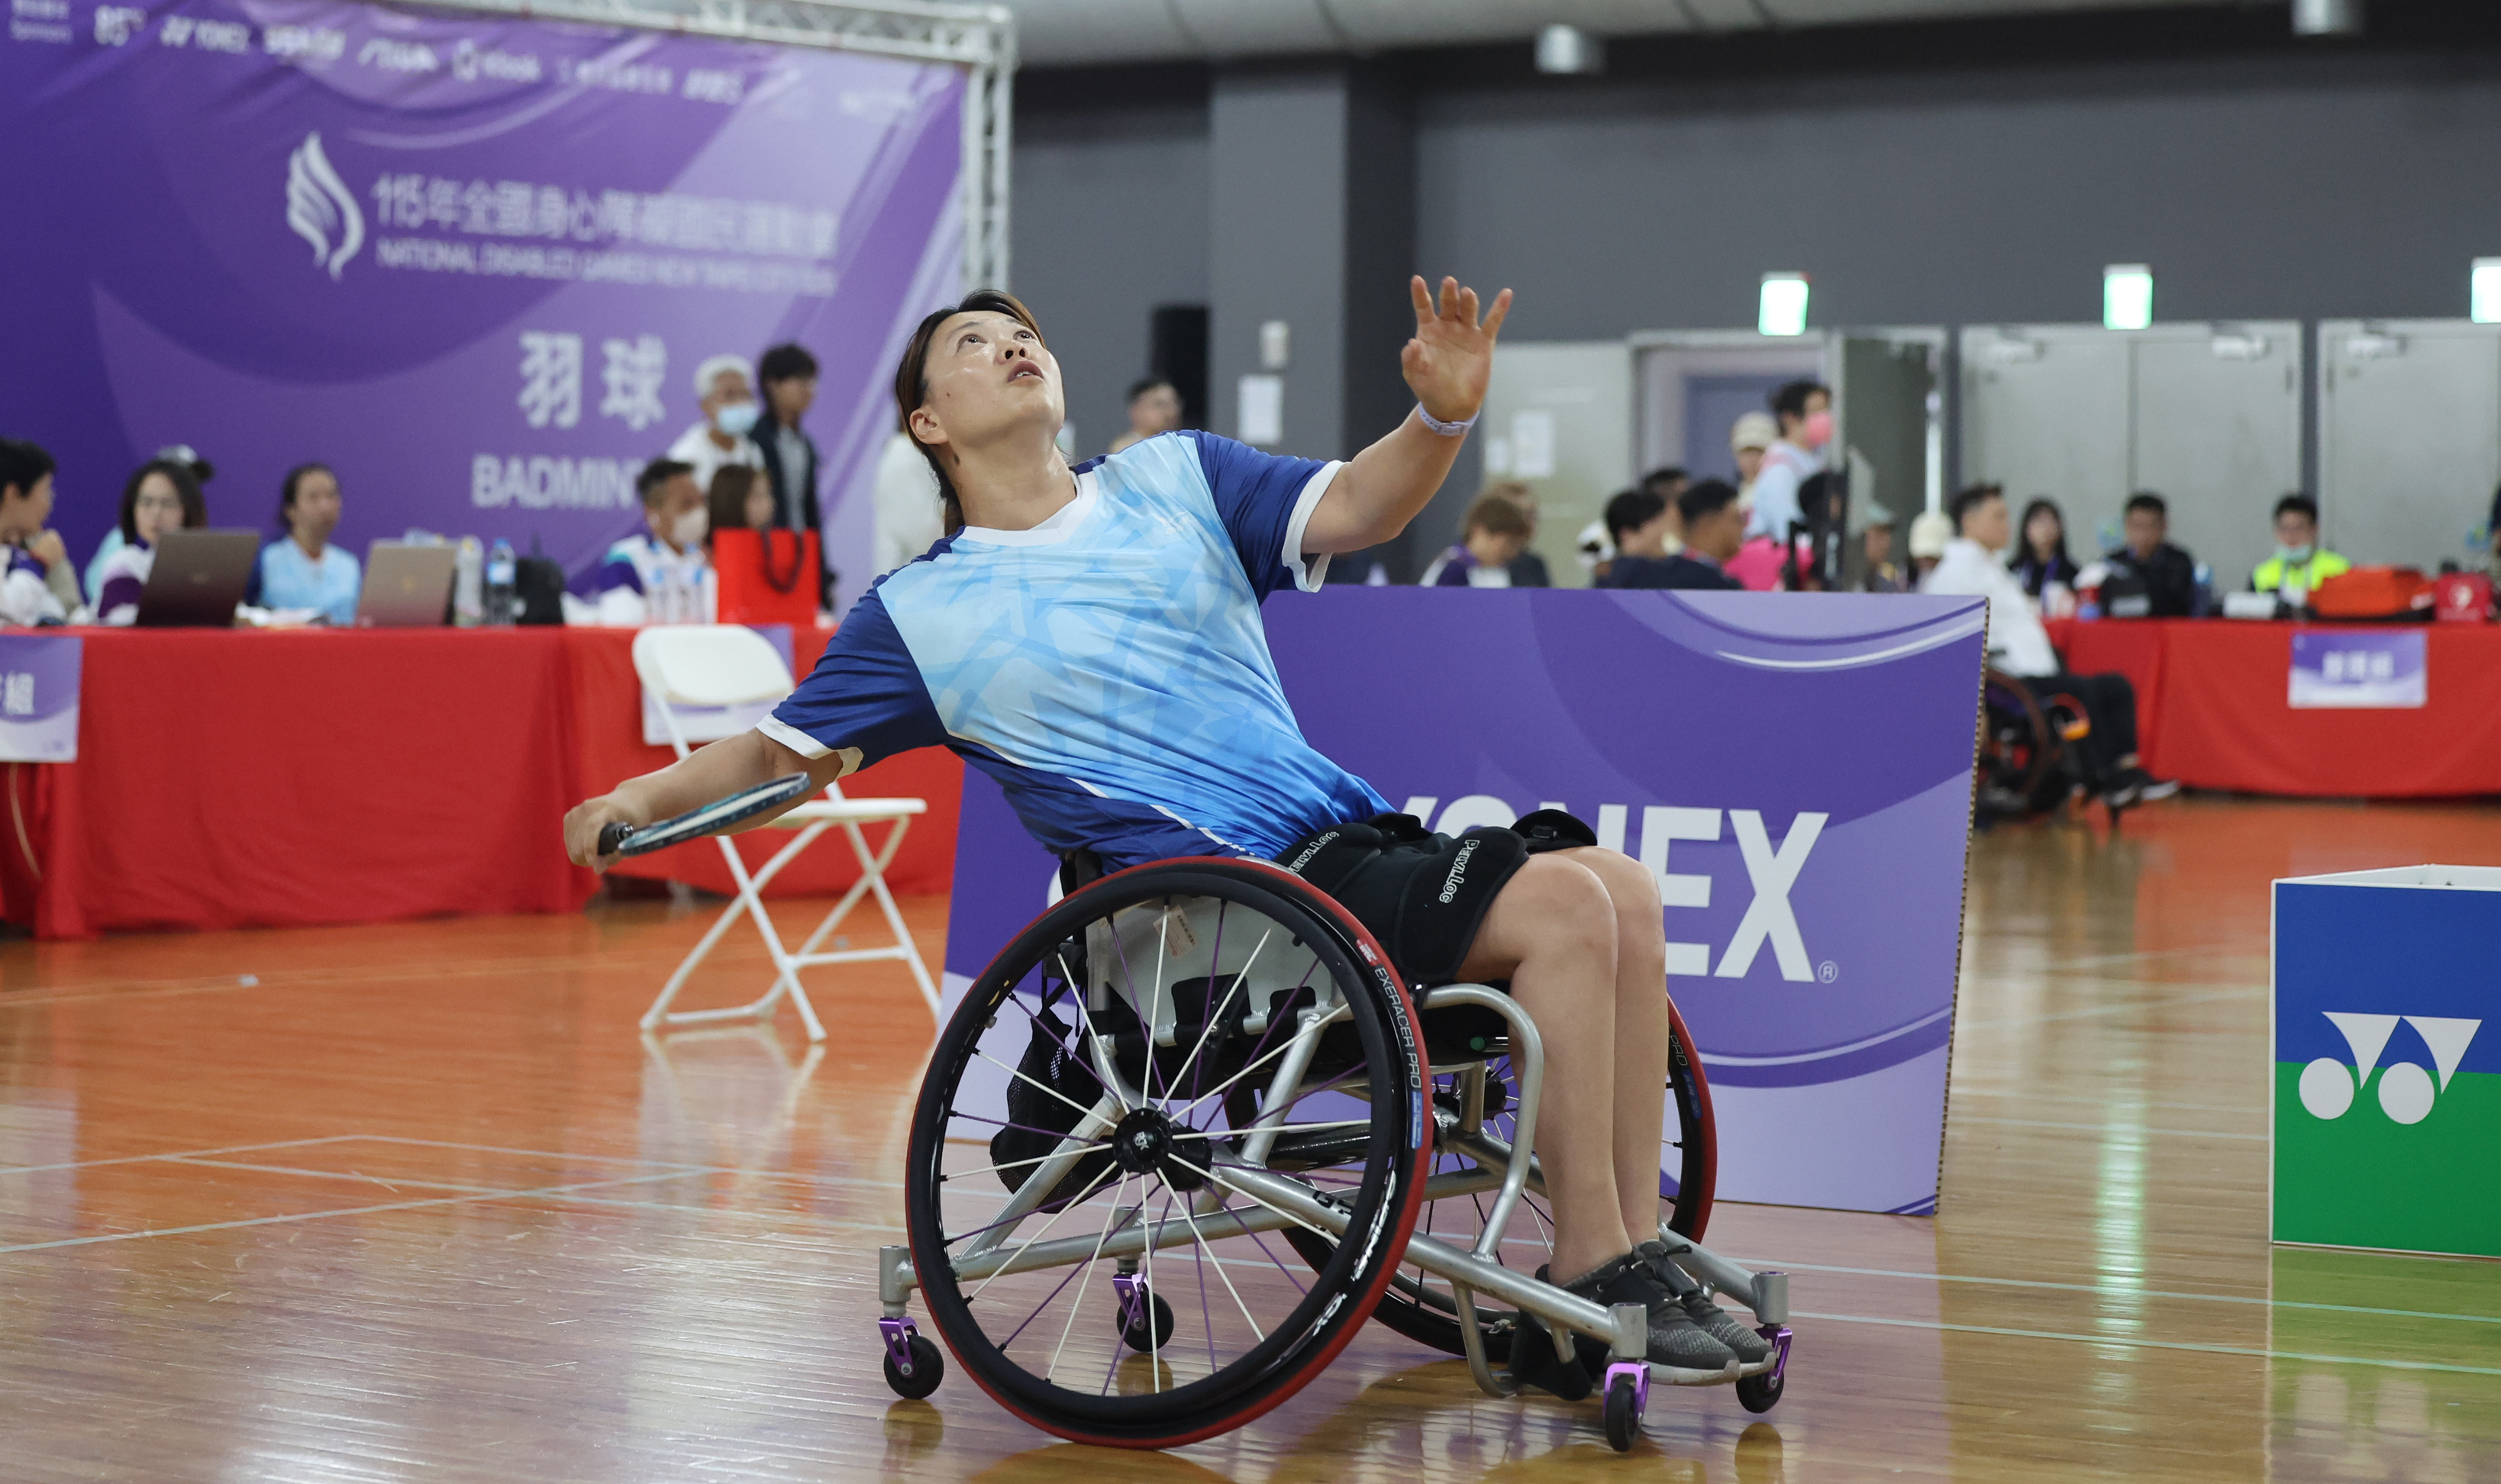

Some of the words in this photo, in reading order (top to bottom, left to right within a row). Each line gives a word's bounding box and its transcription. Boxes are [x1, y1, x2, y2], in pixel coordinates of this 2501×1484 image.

[518, 331, 667, 430] 羽球
[472, 454, 643, 509] BADMIN
[1374, 966, 1415, 1047] EXERACER
[1407, 1052, 1422, 1089] PRO
